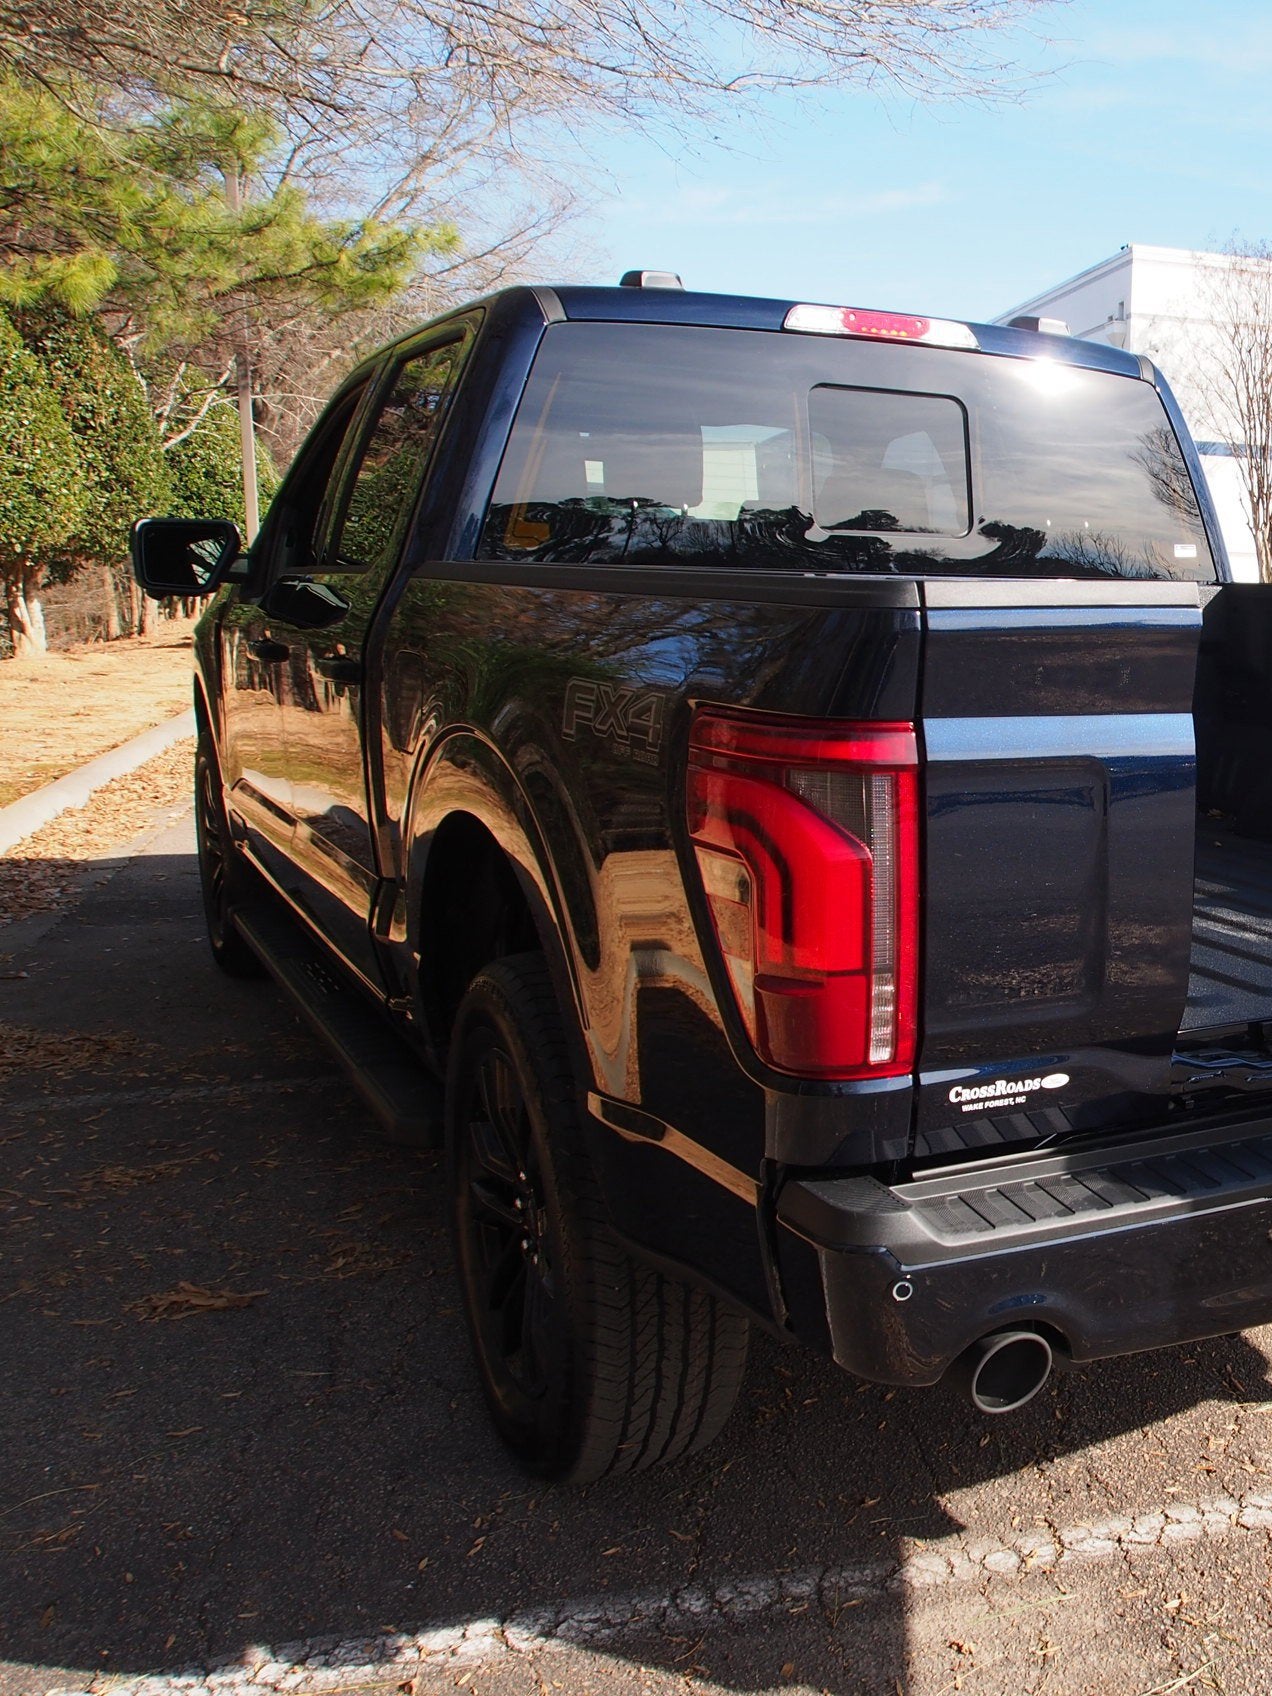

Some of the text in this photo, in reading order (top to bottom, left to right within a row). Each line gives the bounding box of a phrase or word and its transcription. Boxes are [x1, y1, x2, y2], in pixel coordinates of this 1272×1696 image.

[561, 675, 666, 752] FX4
[961, 1095, 1027, 1112] WAKE FOREST, NC
